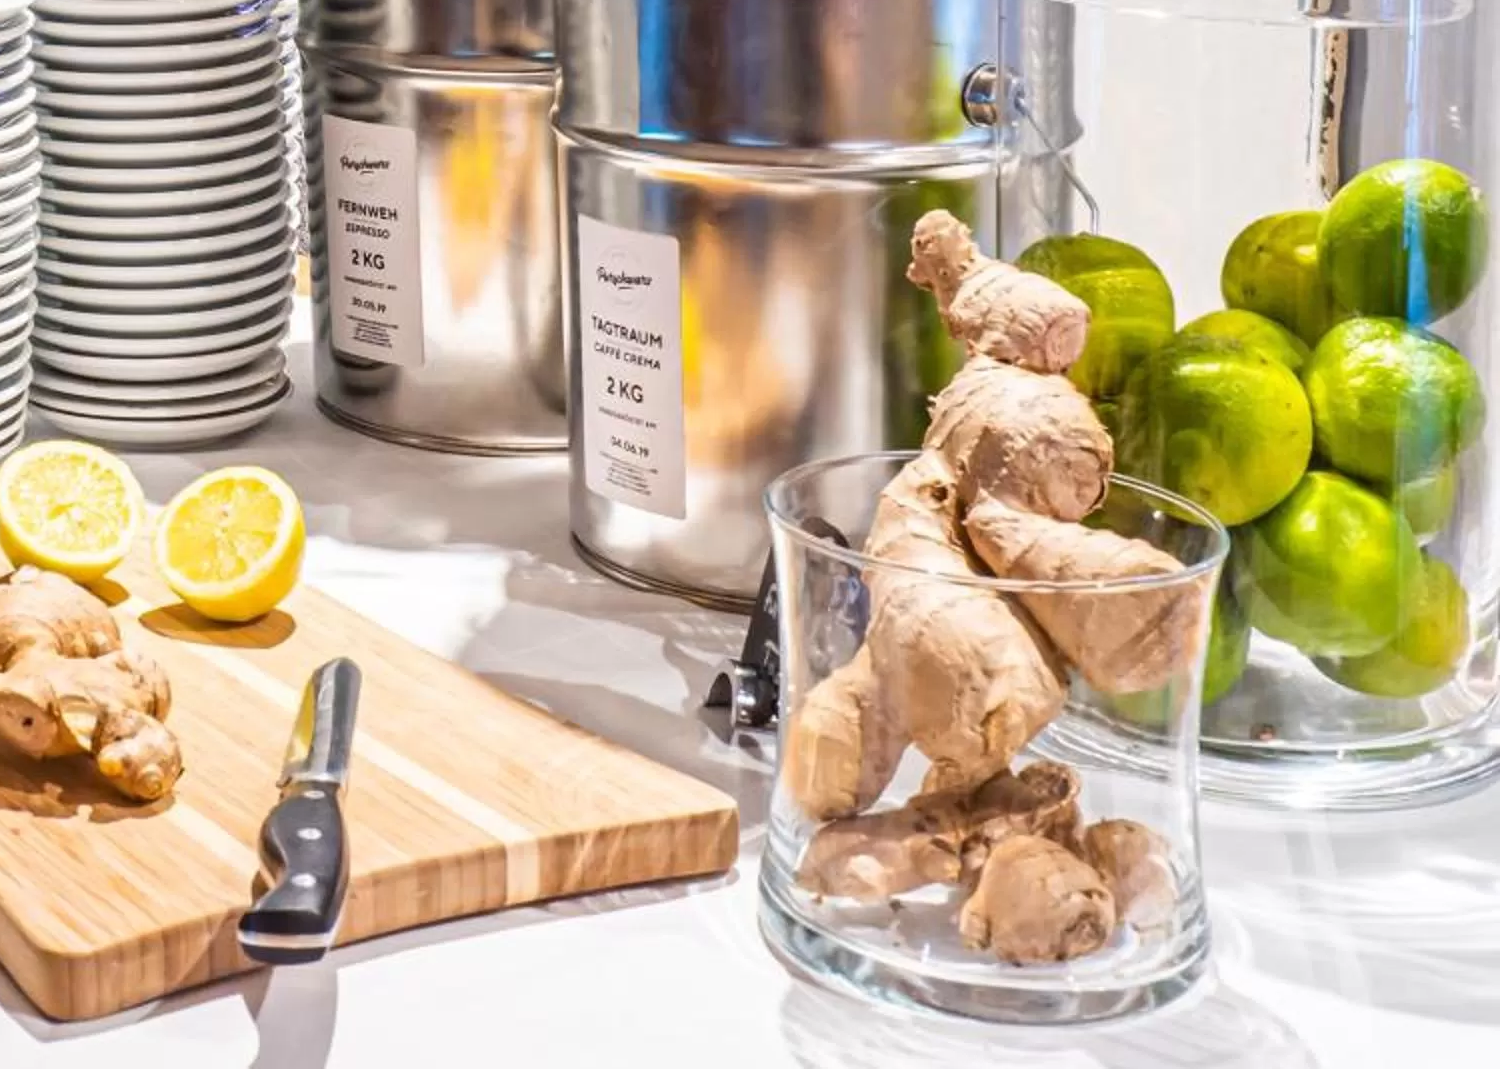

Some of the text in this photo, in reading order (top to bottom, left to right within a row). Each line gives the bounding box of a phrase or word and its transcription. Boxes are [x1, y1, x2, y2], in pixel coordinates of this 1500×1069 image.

[338, 198, 398, 221] FERNWEH
[345, 222, 391, 239] ESPRESSO
[351, 249, 385, 270] 2 KG
[592, 314, 663, 349] TAGTRAUM
[623, 352, 661, 371] CREMA
[607, 376, 644, 404] 2 KG
